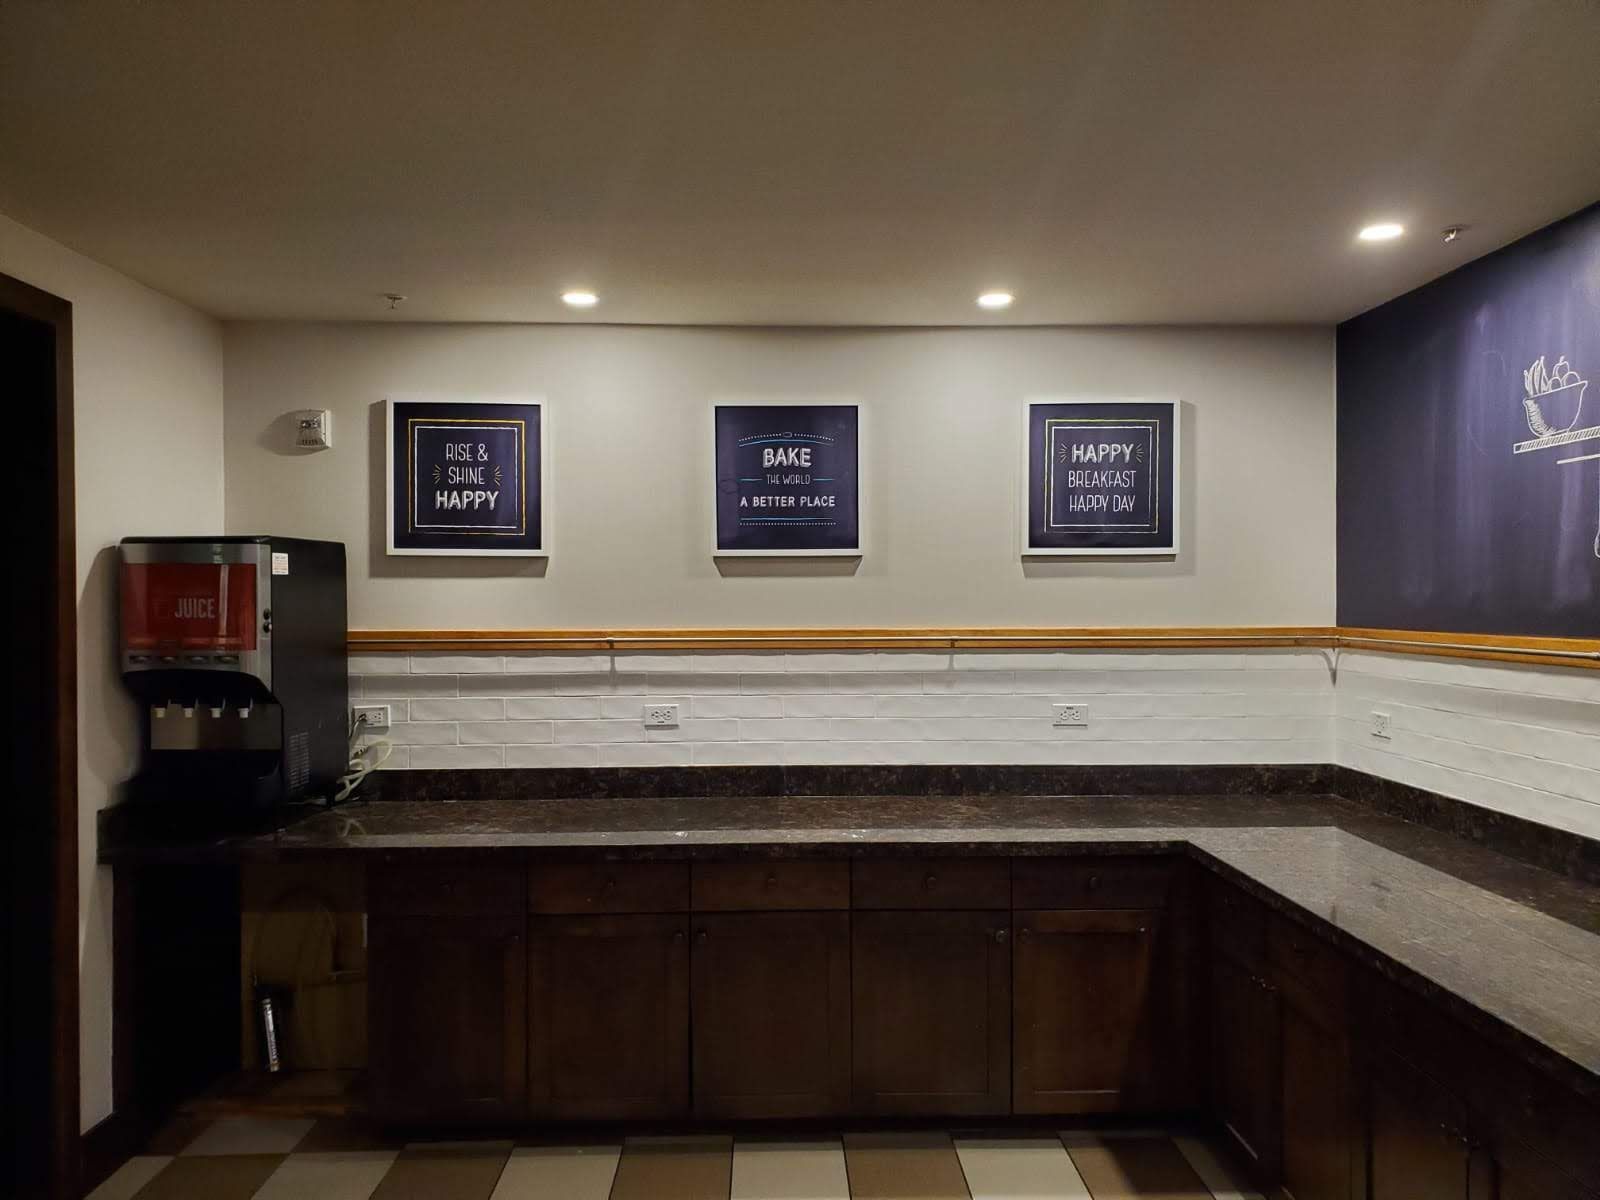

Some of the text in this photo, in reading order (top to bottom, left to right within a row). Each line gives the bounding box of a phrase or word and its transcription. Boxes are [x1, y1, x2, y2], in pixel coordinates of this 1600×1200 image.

[446, 443, 489, 461] RISE &
[762, 448, 812, 468] BAKE
[1071, 443, 1134, 464] HAPPY
[448, 466, 486, 485] SHINE
[766, 474, 811, 485] THE WORLD
[1068, 470, 1137, 488] BREAKFAST
[435, 490, 500, 511] HAPPY
[739, 495, 836, 508] A BETTER PLACE
[1069, 495, 1136, 512] HAPPY DAY
[174, 598, 216, 619] JUICE
